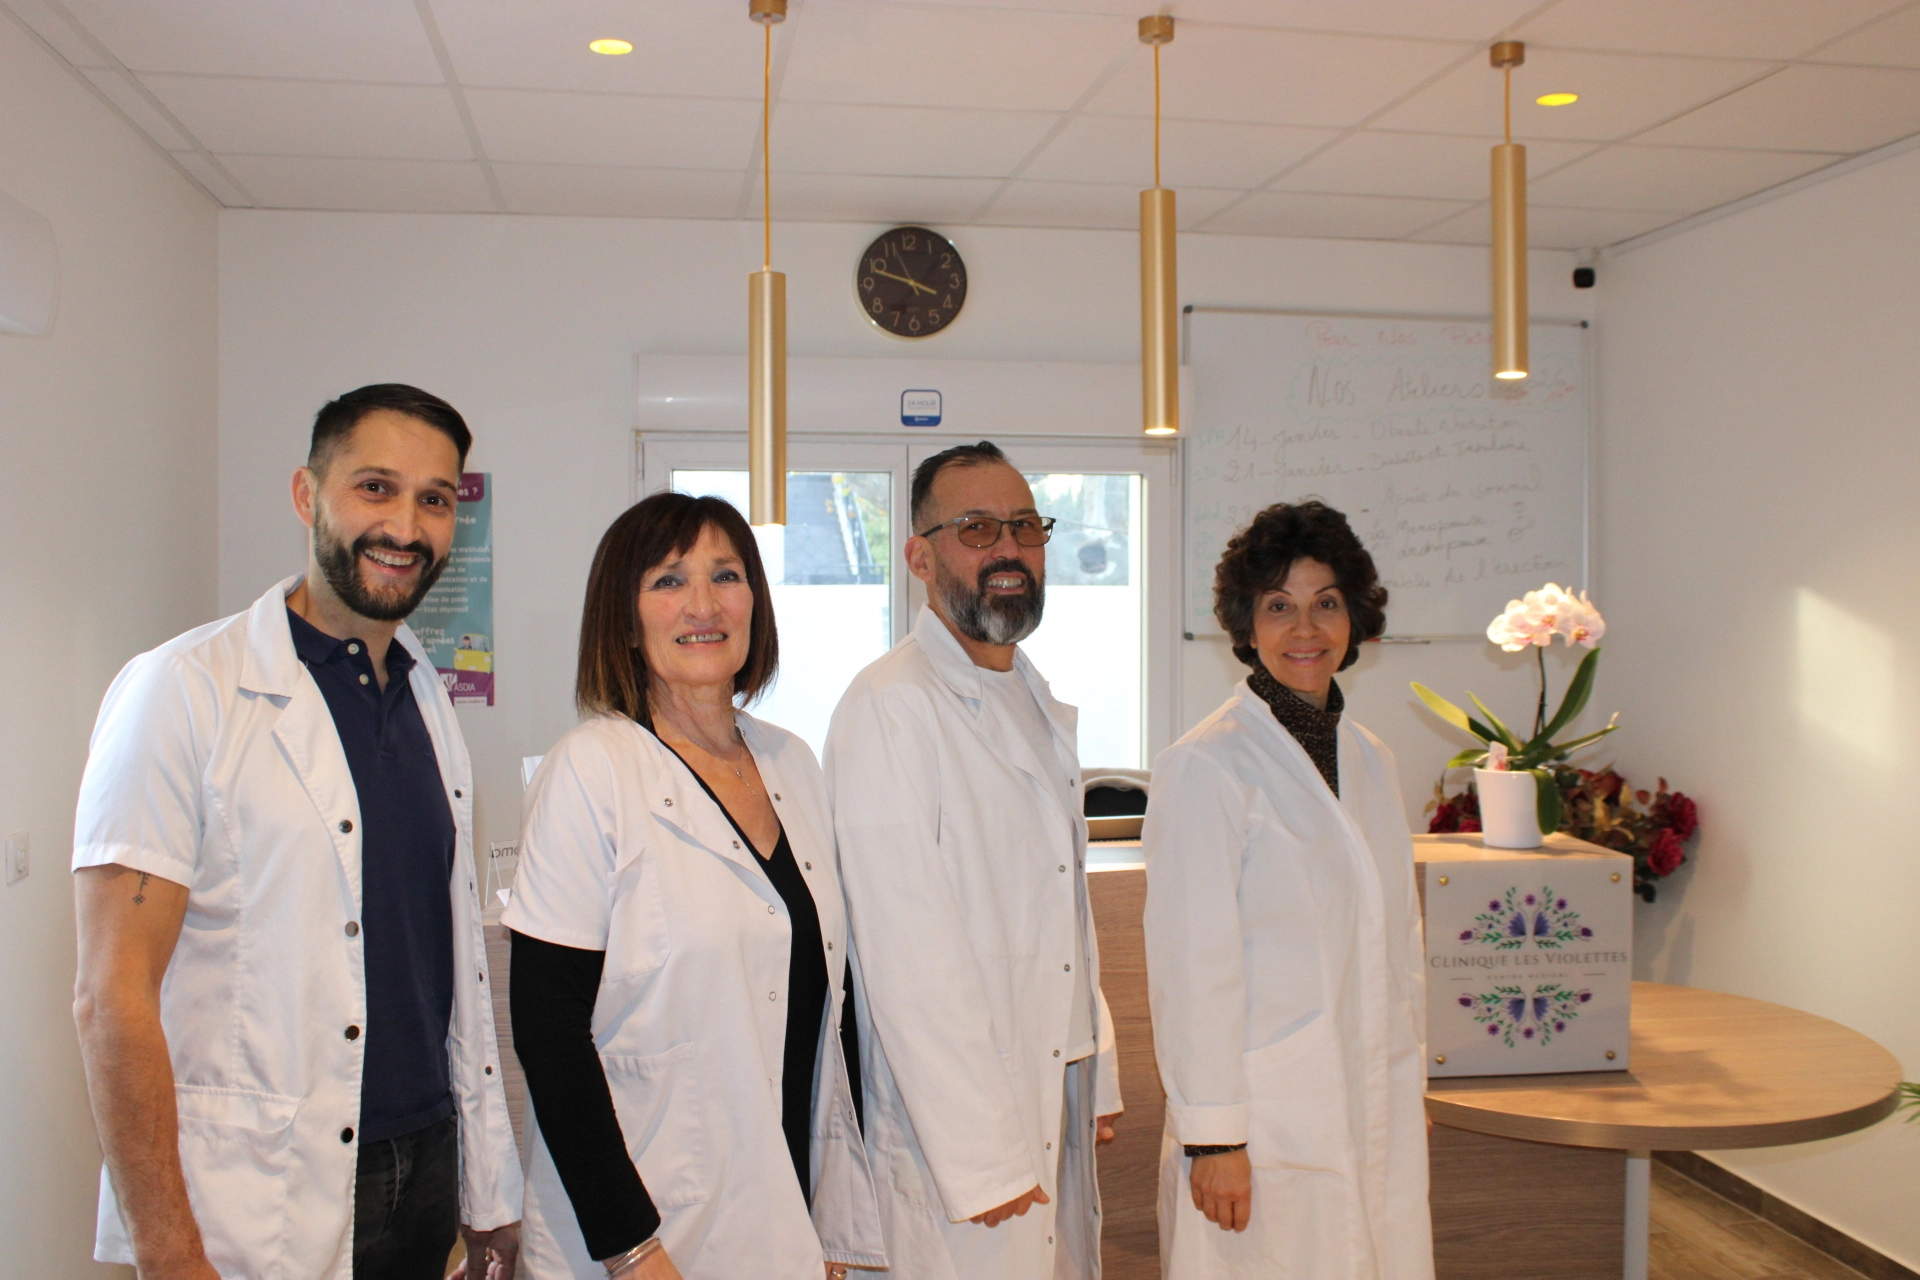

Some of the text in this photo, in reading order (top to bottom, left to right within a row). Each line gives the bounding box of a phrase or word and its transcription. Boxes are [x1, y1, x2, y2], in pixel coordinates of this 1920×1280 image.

[884, 242, 896, 258] 11
[902, 234, 916, 250] 12
[927, 240, 932, 255] 1
[869, 258, 887, 273] 10
[941, 252, 951, 269] 2
[863, 276, 875, 293] 9
[949, 273, 960, 289] 3
[872, 297, 883, 314] 8
[942, 293, 953, 309] 4
[890, 310, 900, 328] 7
[908, 315, 920, 332] 6
[928, 308, 940, 325] 5
[1307, 364, 1357, 408] Nos
[454, 682, 476, 691] ASDIA
[1430, 951, 1628, 970] CLINIQUE LES VIOLETTES
